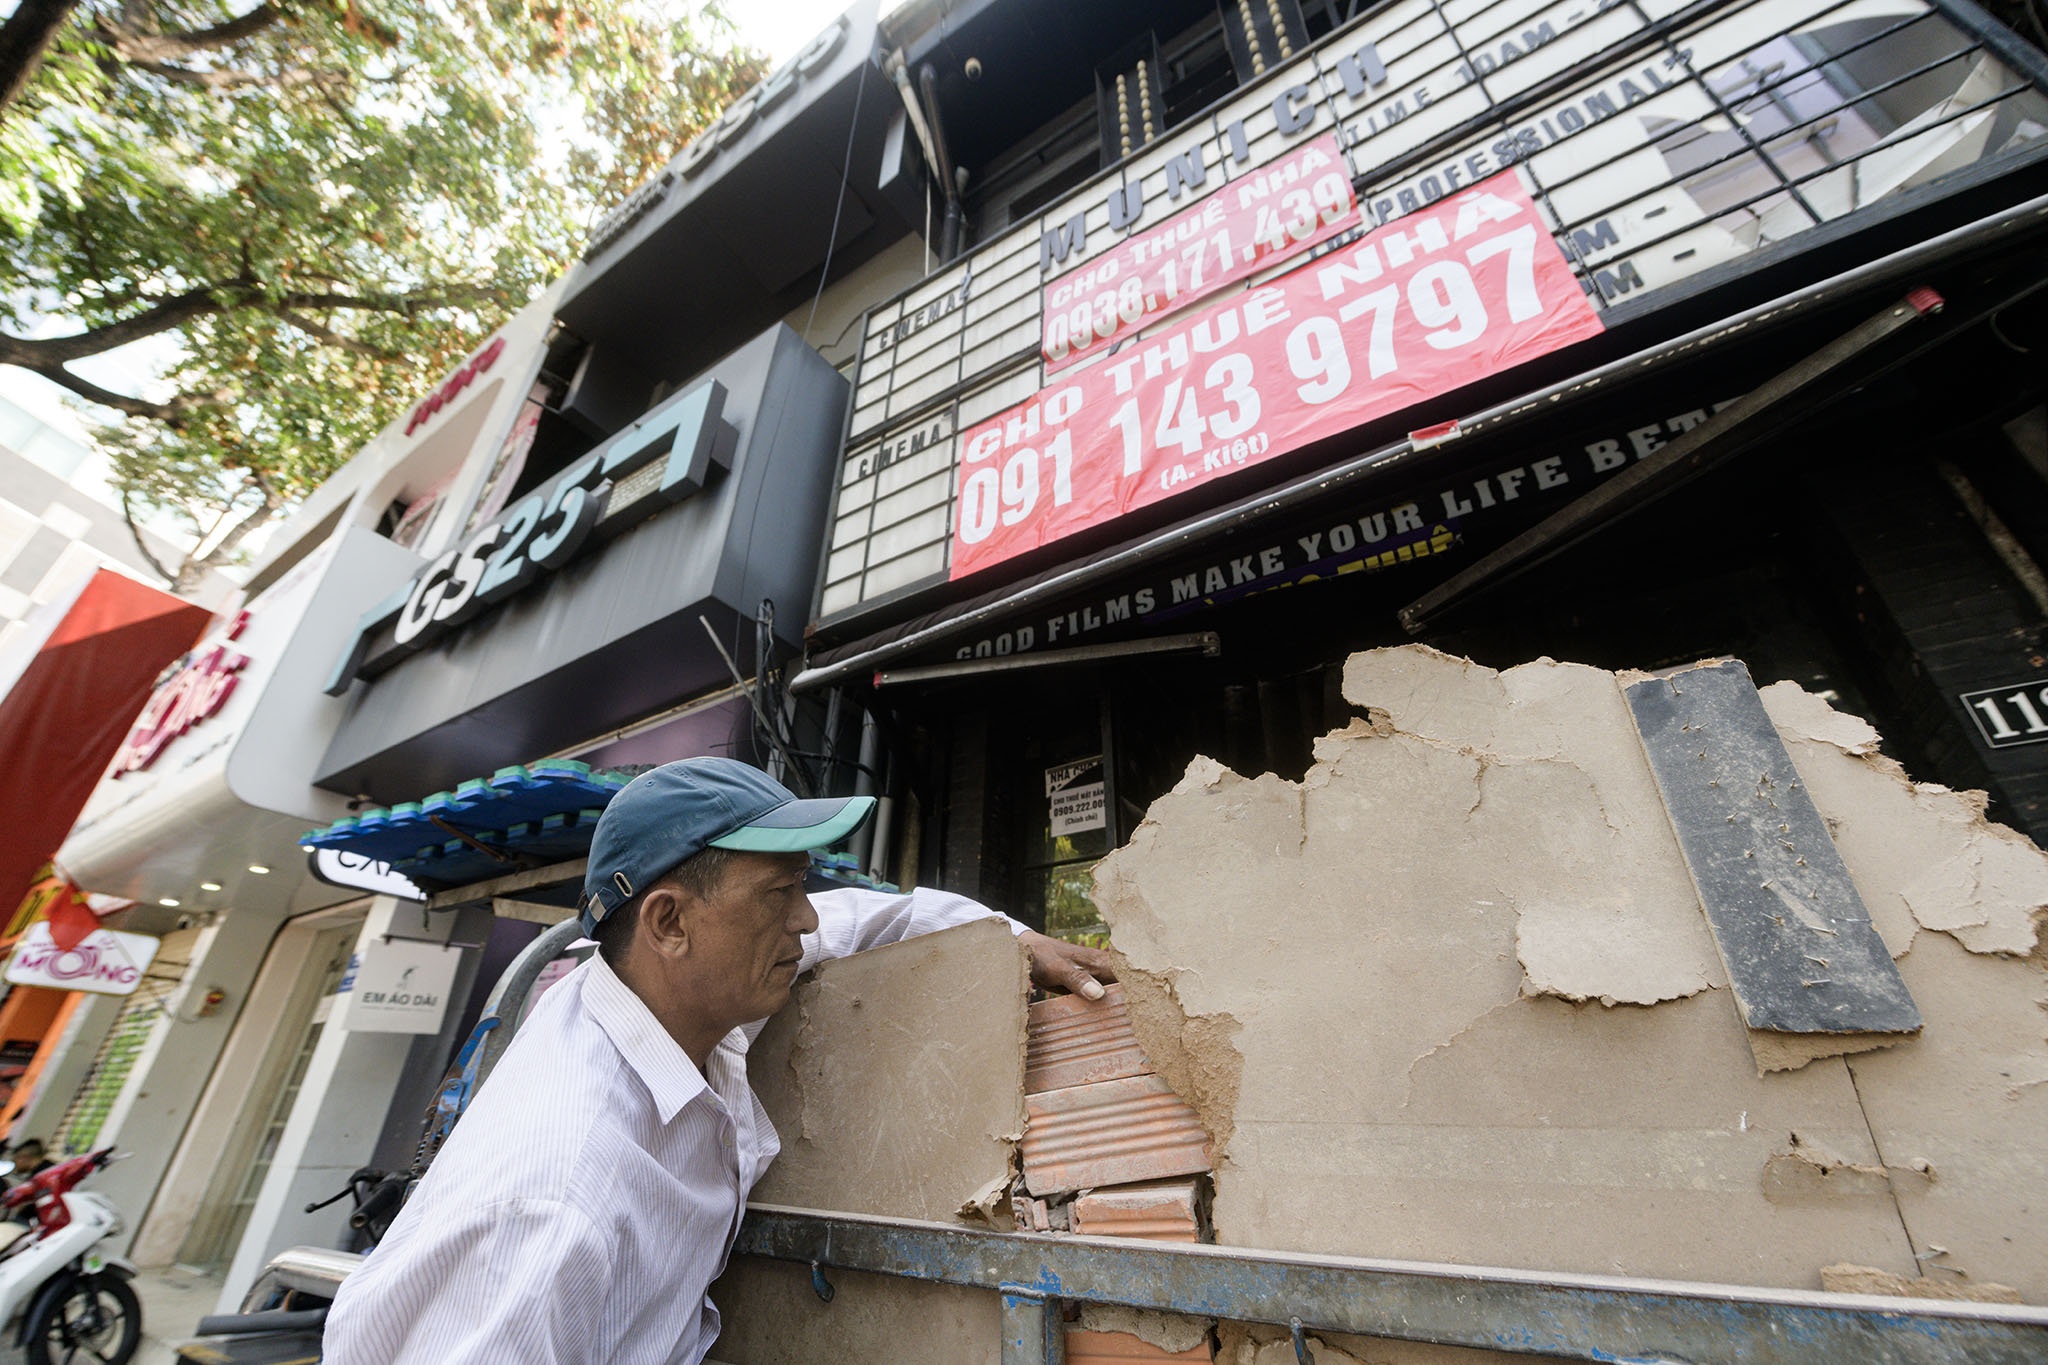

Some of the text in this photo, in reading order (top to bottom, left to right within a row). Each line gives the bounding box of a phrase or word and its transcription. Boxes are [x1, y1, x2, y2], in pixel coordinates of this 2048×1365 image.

[1039, 42, 1388, 272] MUNICH
[1346, 86, 1434, 144] TIME
[1046, 172, 1351, 363] 0938.171.439
[1050, 145, 1332, 307] CHO THUÊ NHÀ
[879, 292, 956, 350] CINEMA
[960, 222, 1539, 546] 091 143 9797
[966, 191, 1524, 464] CHO THUÊ NHÀ
[858, 423, 941, 479] CINEMA
[1161, 431, 1269, 489] (A. Kiệt)
[394, 456, 602, 645] GS25
[1047, 588, 1155, 642] FILMS
[1170, 546, 1285, 603] MAKE
[1297, 503, 1424, 563] YOUR
[1445, 455, 1569, 520] LIFE
[1053, 799, 1105, 817] 0909.222.00
[361, 991, 386, 1004] EM
